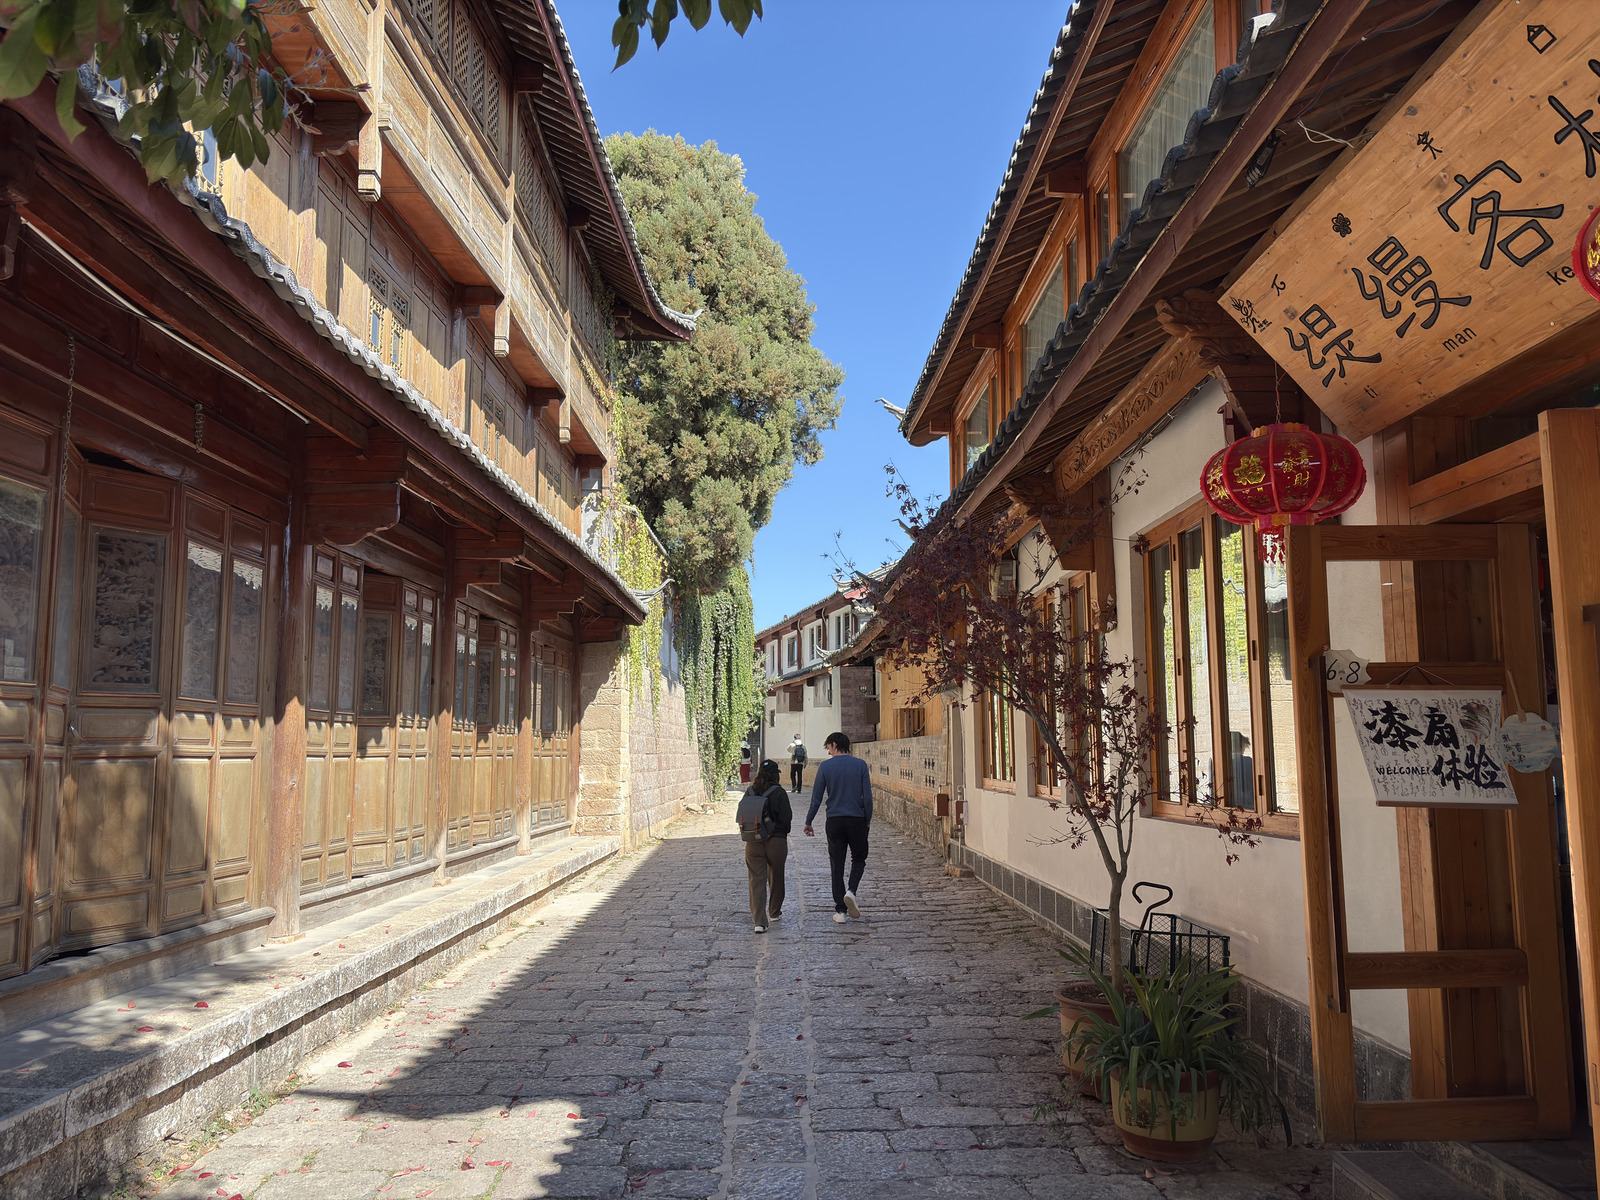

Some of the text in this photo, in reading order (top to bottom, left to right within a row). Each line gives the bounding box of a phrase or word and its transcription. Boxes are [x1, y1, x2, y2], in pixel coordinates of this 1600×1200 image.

[1442, 327, 1477, 352] man
[1546, 266, 1576, 286] ke
[1364, 700, 1460, 752] 漆扇
[1432, 744, 1507, 791] 体验
